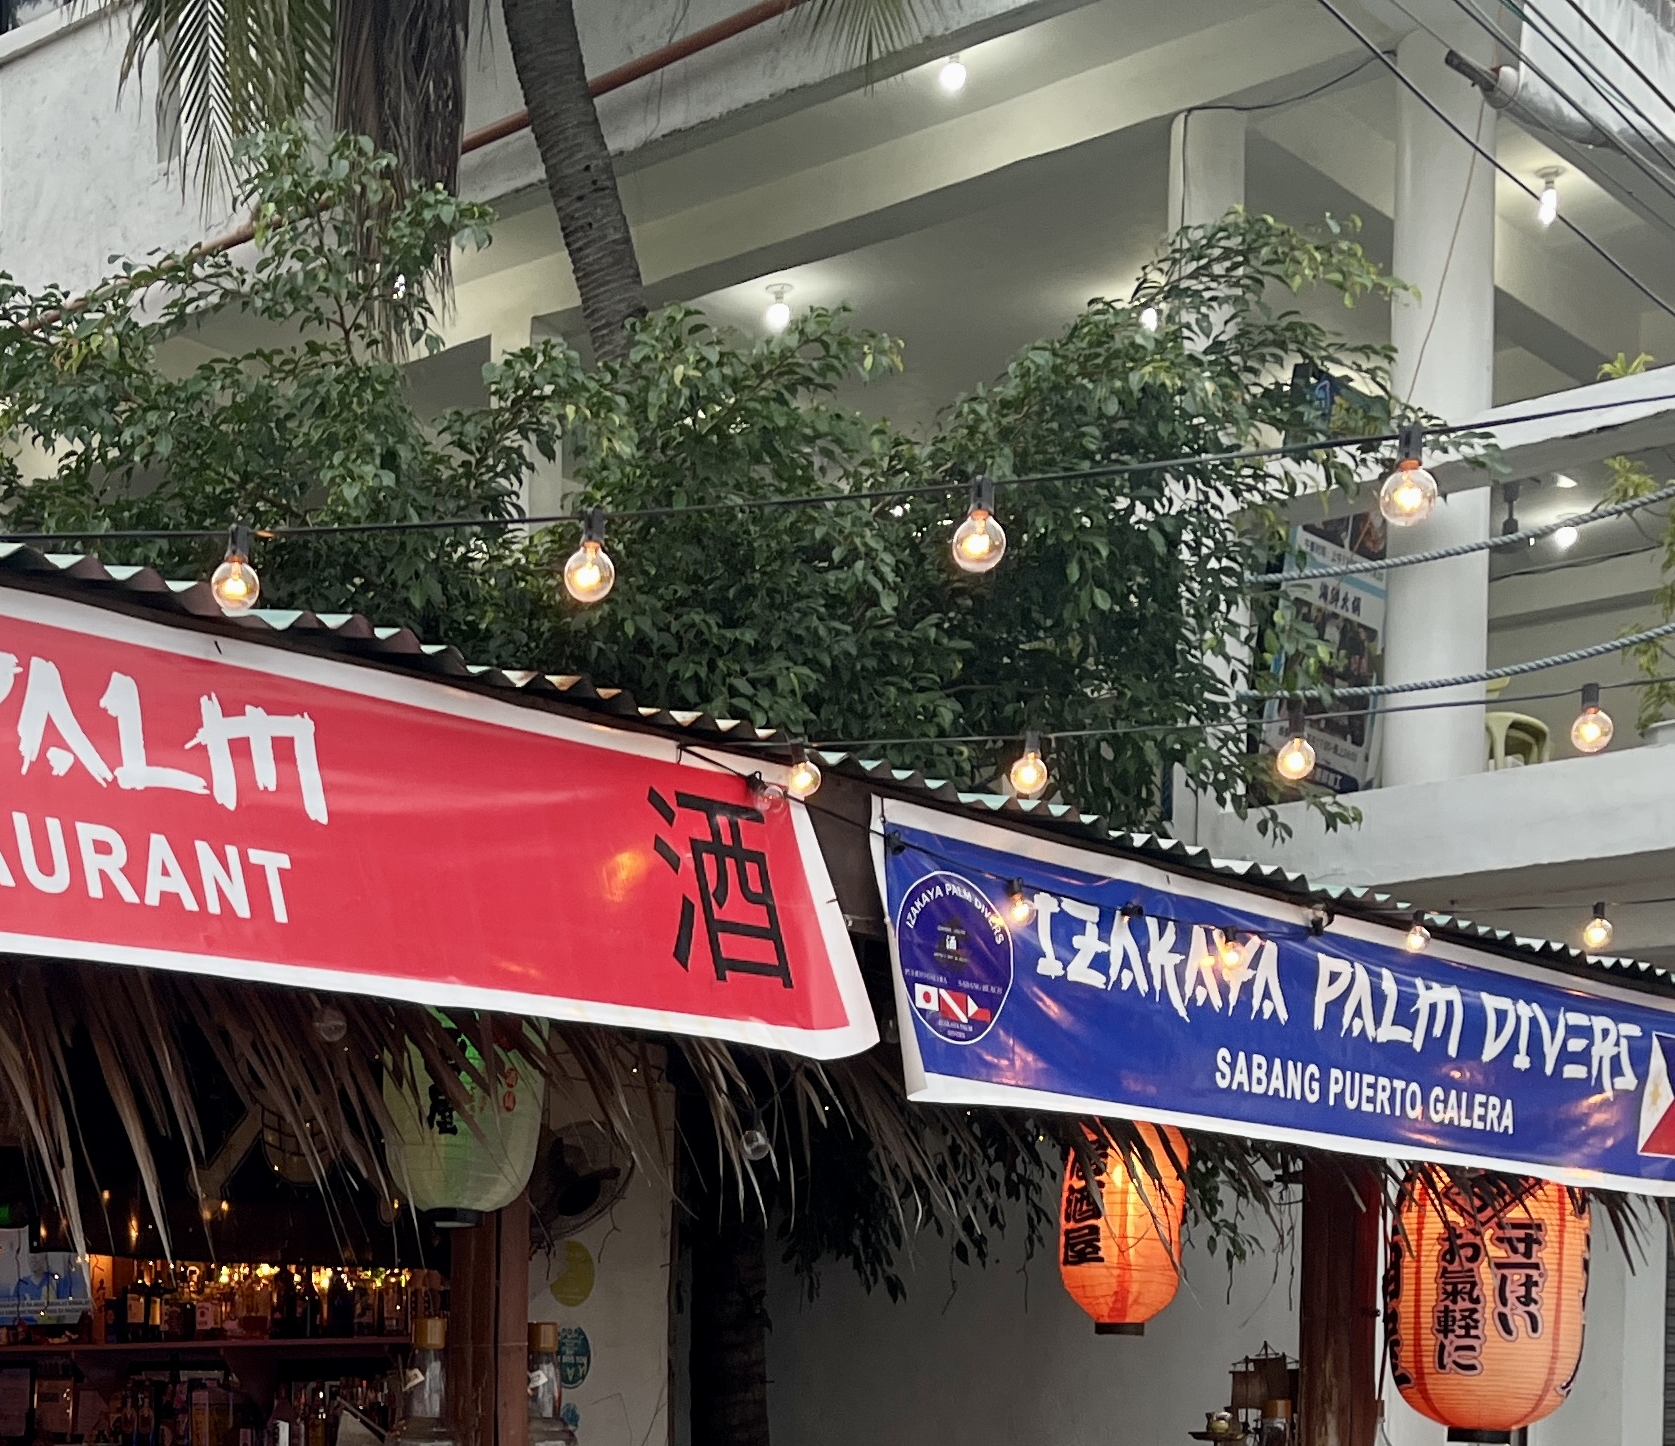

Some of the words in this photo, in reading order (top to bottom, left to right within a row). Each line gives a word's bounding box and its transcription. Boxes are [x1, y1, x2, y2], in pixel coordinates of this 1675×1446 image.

[646, 785, 794, 990] 酒
[905, 885, 943, 929] IZAKAYA
[944, 882, 972, 903] PALM
[973, 897, 1005, 945] DIVERS
[1034, 892, 1288, 1025] IZAKAYA
[1313, 953, 1463, 1058] PALM
[1480, 990, 1643, 1099] DIVERS
[1214, 1046, 1320, 1104] SABANG
[1328, 1067, 1422, 1119] PUERTO
[1429, 1085, 1514, 1135] GALERA
